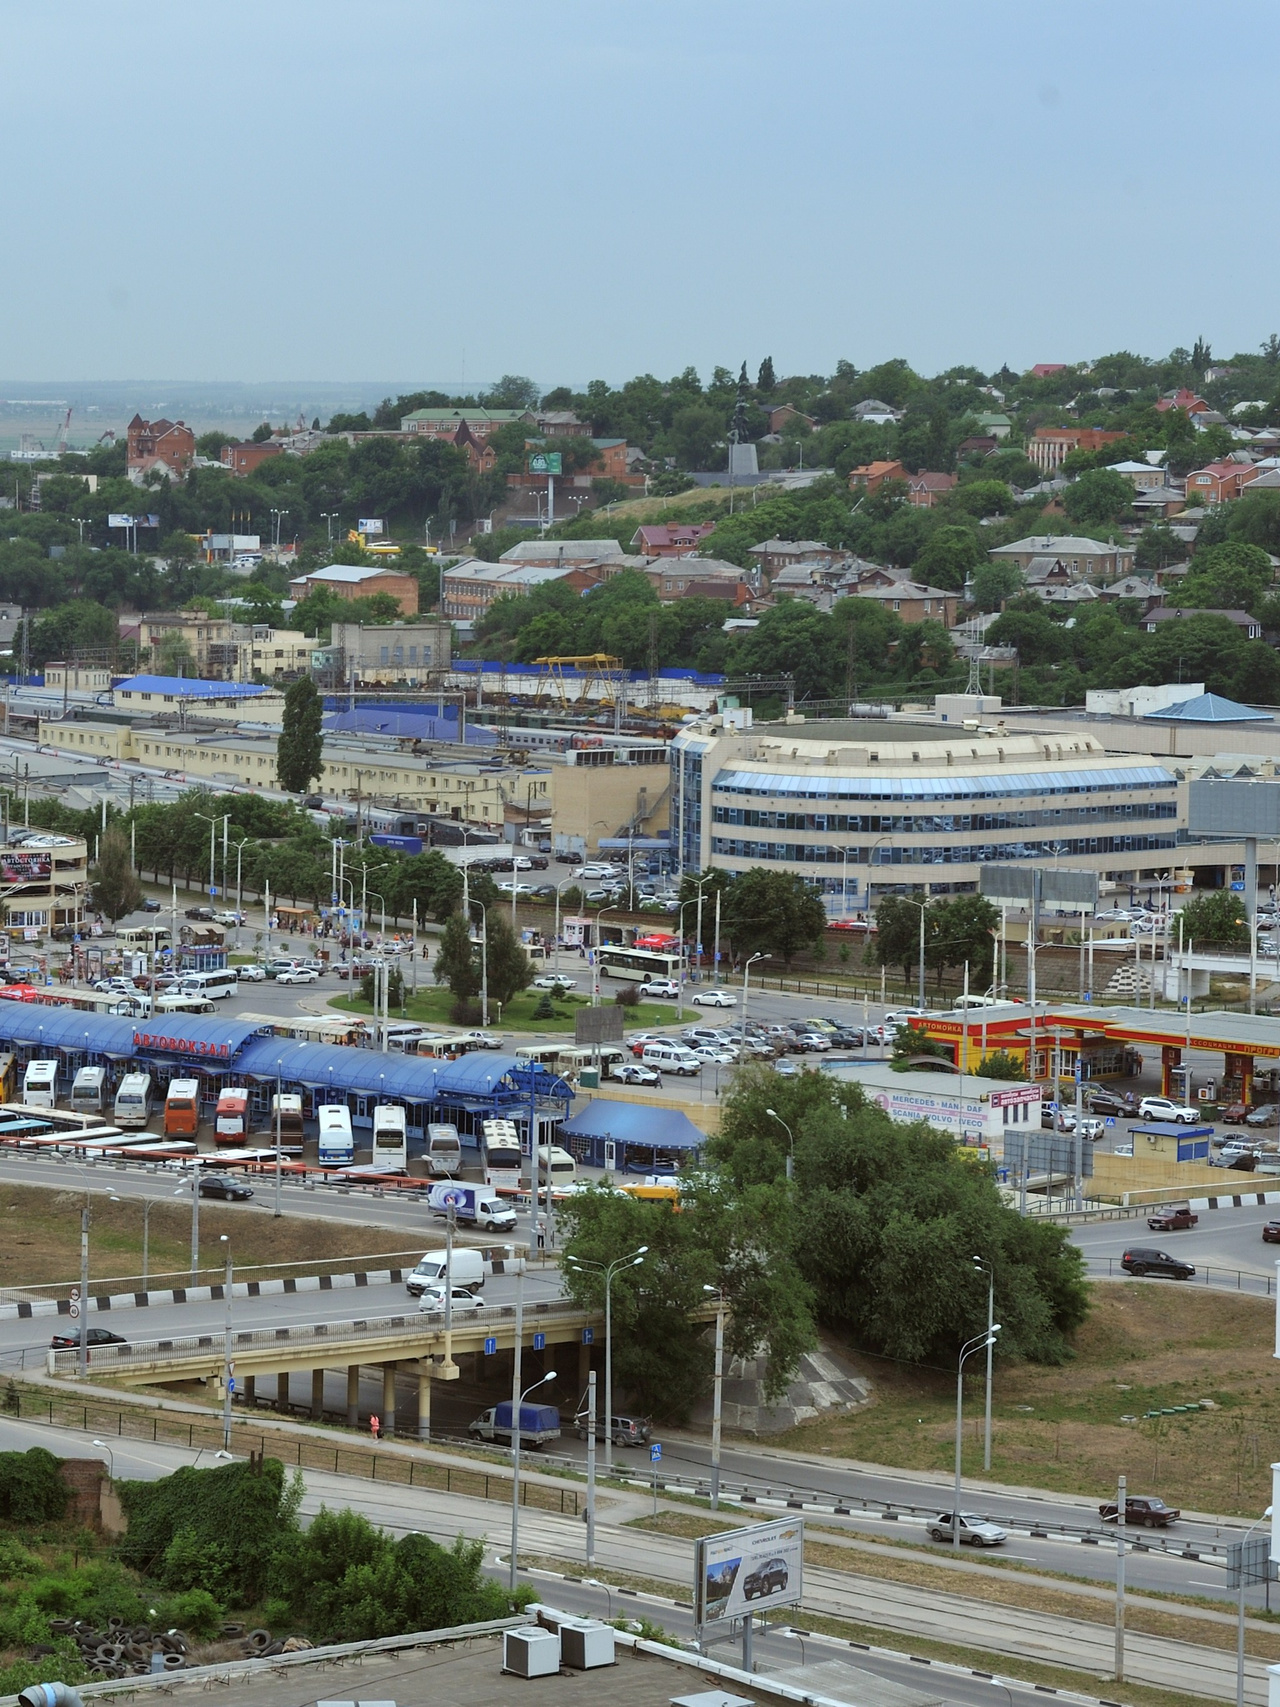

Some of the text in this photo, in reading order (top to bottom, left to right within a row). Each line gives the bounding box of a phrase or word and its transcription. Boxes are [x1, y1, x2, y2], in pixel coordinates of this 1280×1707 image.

[917, 1021, 962, 1033] АВТОМОЙКА
[133, 1032, 229, 1058] АВТОВОКЗАЛ
[1189, 1040, 1237, 1050] АССОЦИАЦИЯ
[892, 1094, 983, 1113] MERCEDES MAN DAF
[892, 1108, 921, 1119] SCANIA
[925, 1114, 953, 1123] VOLVO
[958, 1118, 983, 1127] IVECO
